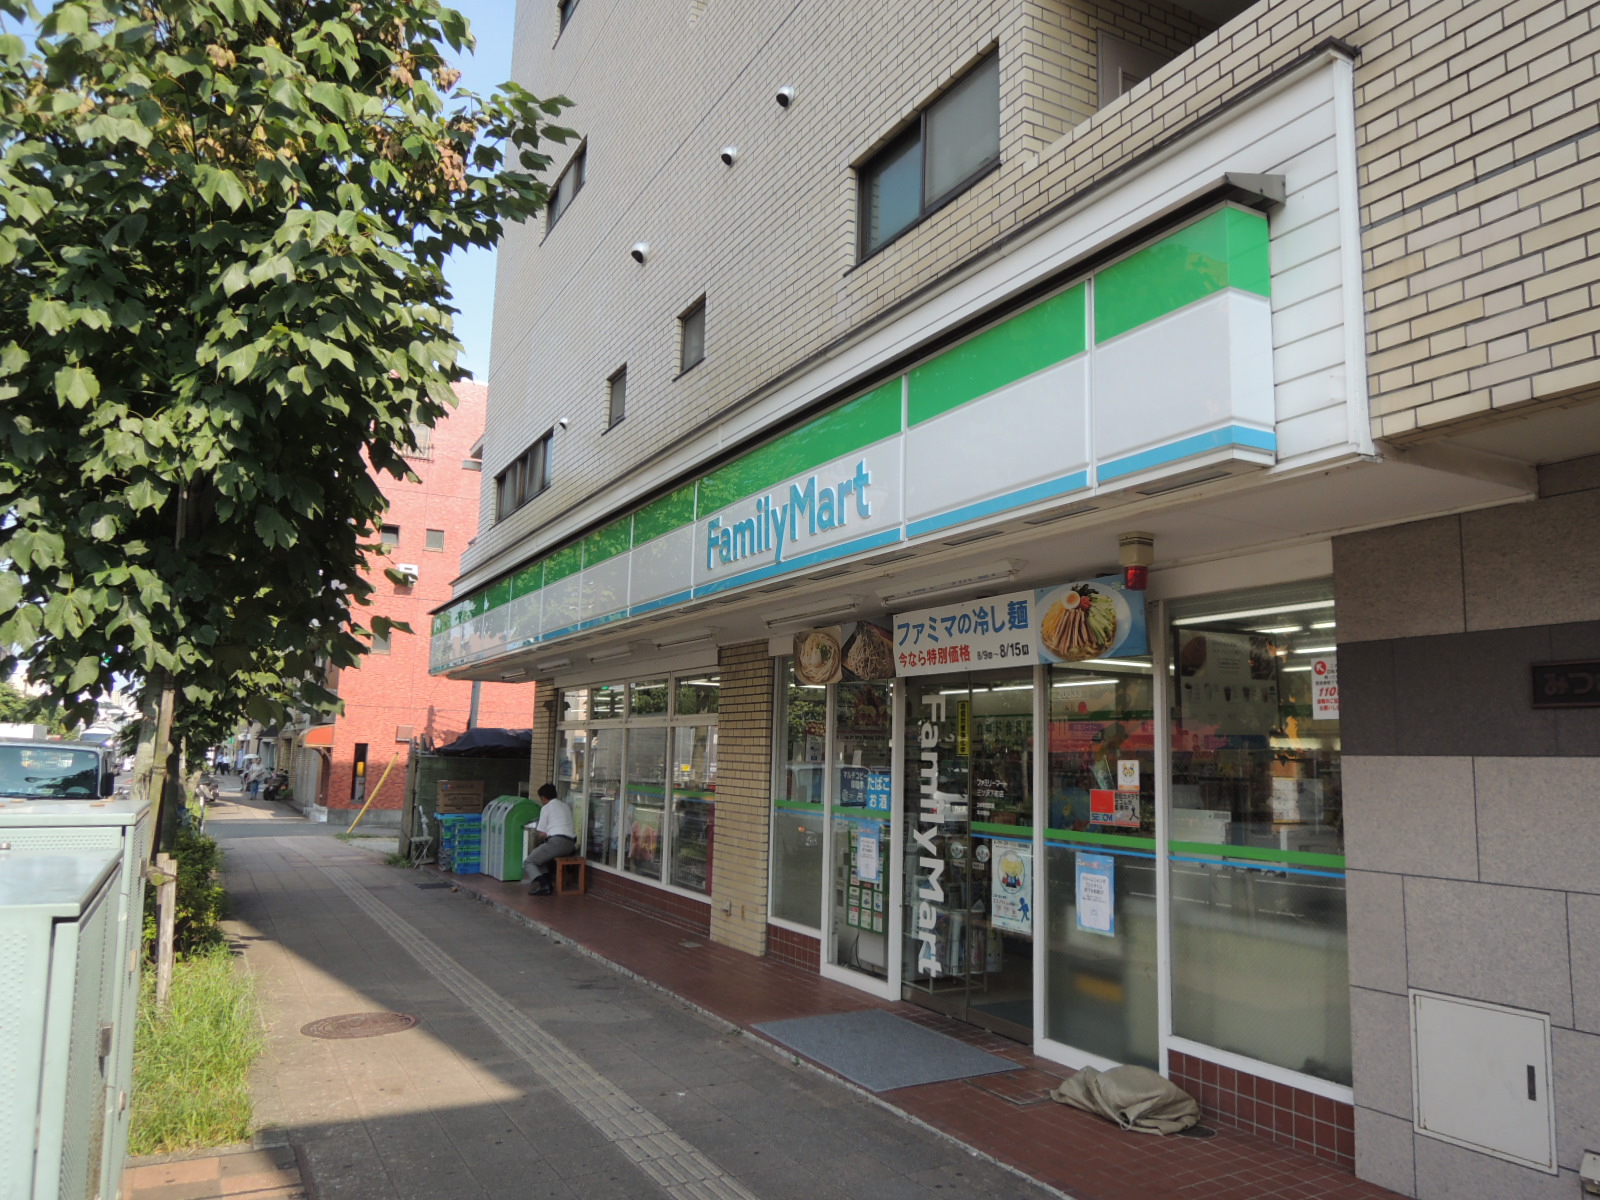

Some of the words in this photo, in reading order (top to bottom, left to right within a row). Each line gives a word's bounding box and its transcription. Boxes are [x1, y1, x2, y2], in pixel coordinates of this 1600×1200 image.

[706, 457, 872, 569] FamilyMart
[897, 600, 1029, 646] ファミマの冷し麺
[898, 644, 971, 668] 今なら特別価格
[867, 776, 890, 791] たばこ
[869, 793, 887, 809] お酒
[913, 695, 945, 978] FamilyMart
